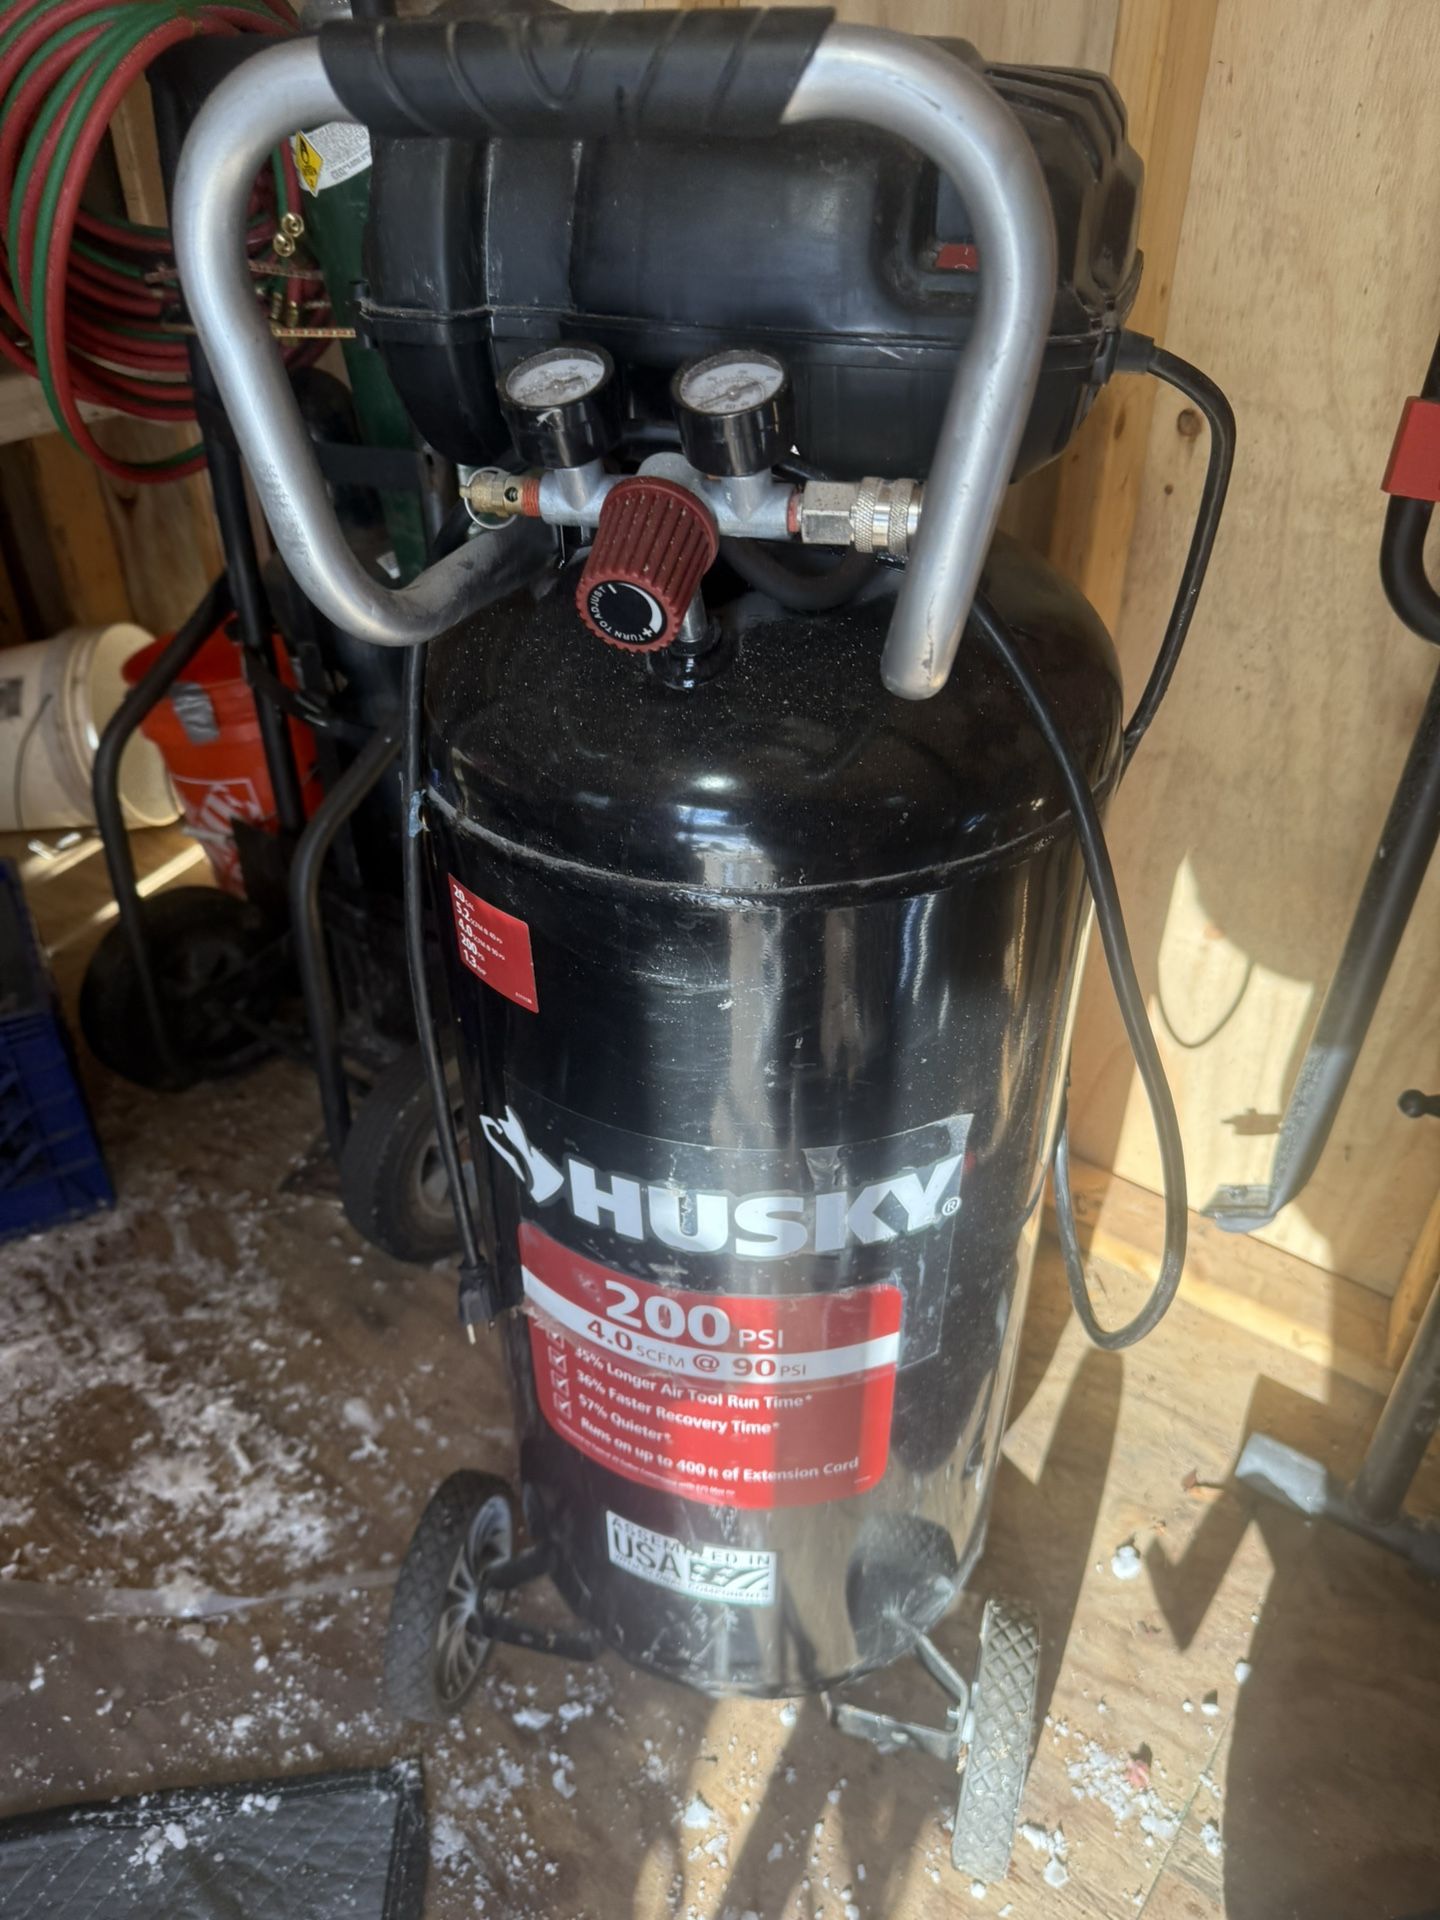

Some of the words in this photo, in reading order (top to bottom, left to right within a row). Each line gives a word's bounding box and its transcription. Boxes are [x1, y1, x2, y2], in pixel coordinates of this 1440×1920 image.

[590, 586, 606, 619] ADJUST
[600, 620, 612, 633] TO
[614, 630, 645, 642] TURN
[456, 901, 471, 921] 5.2
[459, 918, 473, 937] 4.0
[461, 933, 478, 955] 200
[605, 1280, 730, 1346] 200
[738, 1329, 783, 1350] PSI
[587, 1320, 632, 1352] 4.0
[636, 1344, 685, 1369] SCFM
[692, 1353, 720, 1373] @
[732, 1357, 776, 1377] 90
[780, 1363, 807, 1377] PSI
[606, 1362, 657, 1391] Longer
[660, 1384, 683, 1399] Air
[687, 1389, 722, 1406] Tool
[727, 1394, 759, 1409] Run
[576, 1369, 606, 1395] 36%
[608, 1386, 652, 1414] Faster
[656, 1406, 728, 1435] Recovery
[578, 1394, 608, 1419] 57%
[581, 1416, 612, 1443] Runs
[614, 1437, 632, 1454] on
[635, 1446, 653, 1463] up
[656, 1454, 673, 1467] to
[676, 1458, 706, 1477] 400
[722, 1467, 739, 1481] of
[743, 1466, 818, 1483] Extension
[823, 1456, 860, 1474] Cord
[614, 1528, 681, 1578] USA
[749, 1553, 770, 1565] IN
